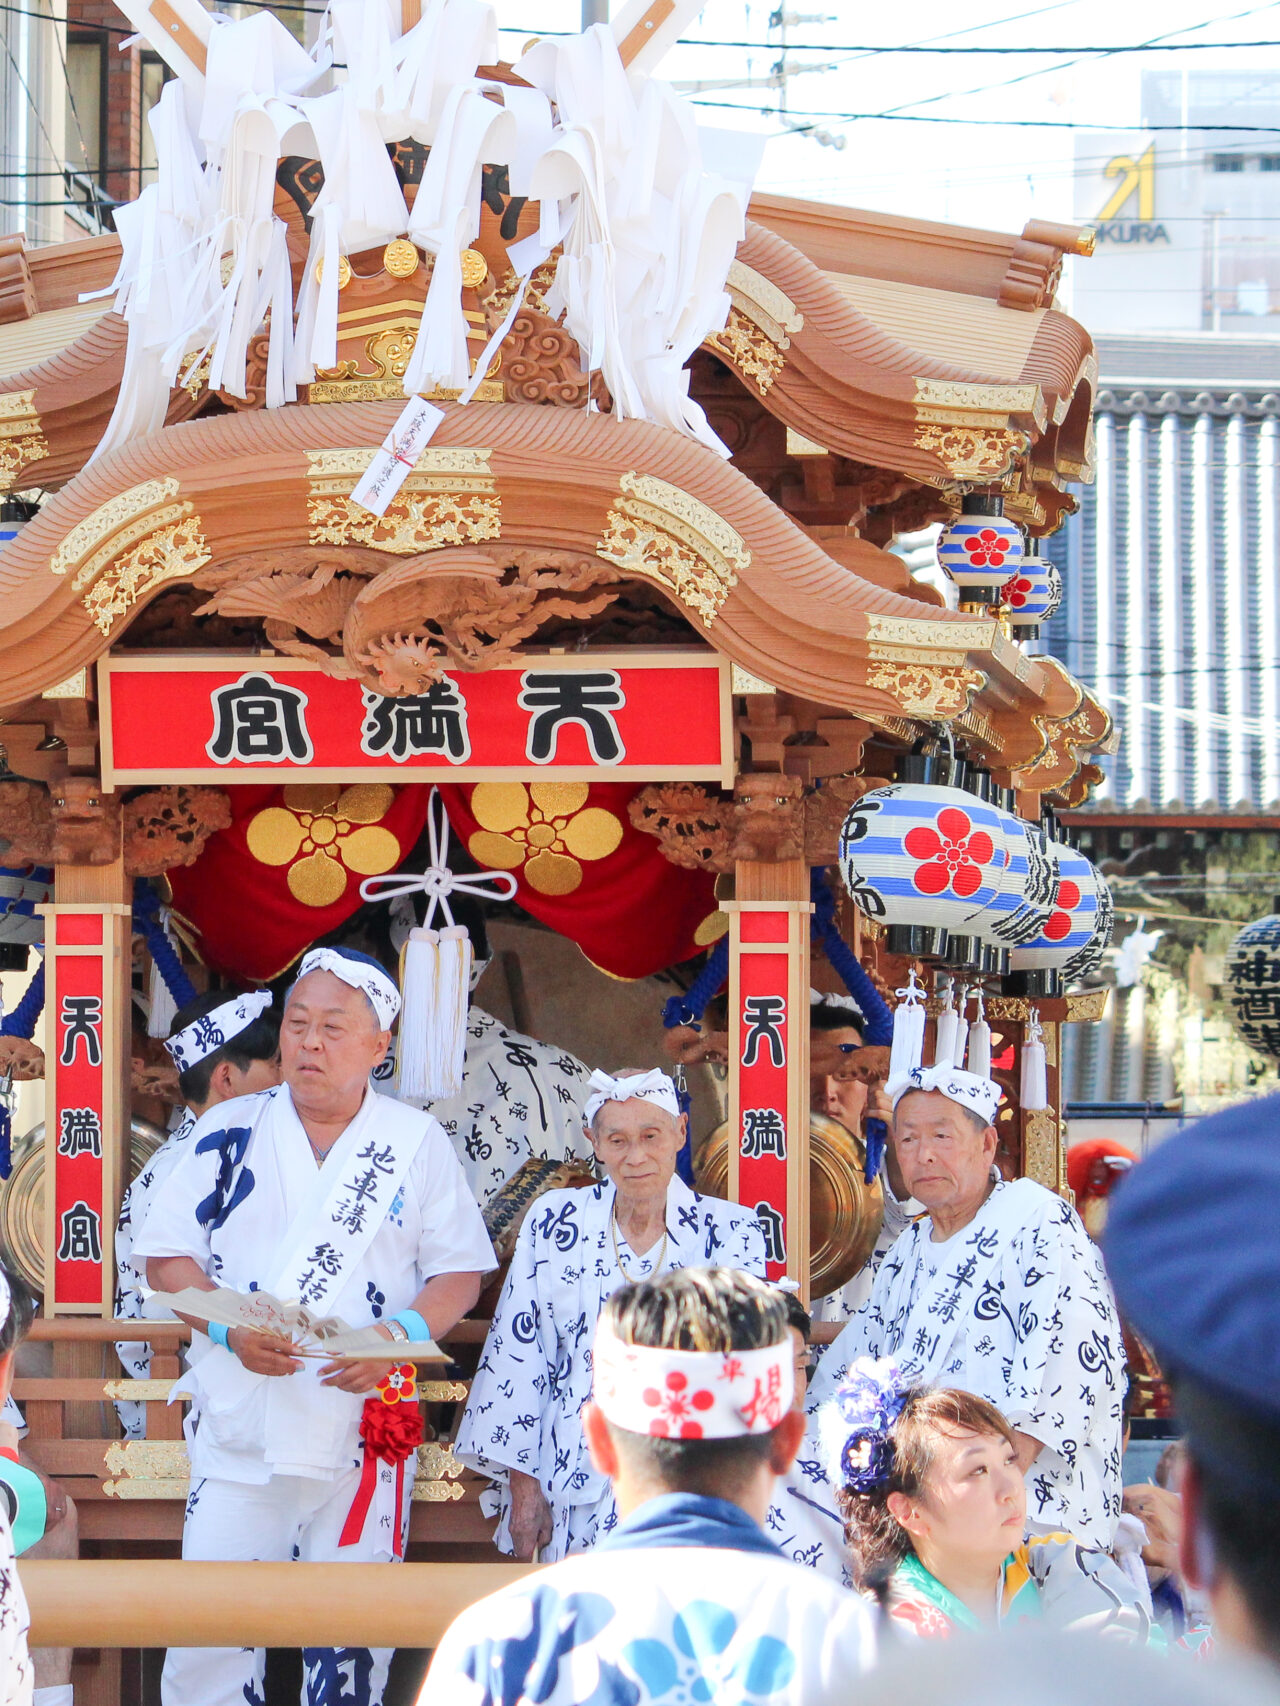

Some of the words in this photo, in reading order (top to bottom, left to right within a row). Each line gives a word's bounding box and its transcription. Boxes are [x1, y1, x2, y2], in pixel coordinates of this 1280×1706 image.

[58, 996, 102, 1265] 天満宮
[331, 1141, 397, 1236] 地車講
[928, 1226, 999, 1325] 地車講
